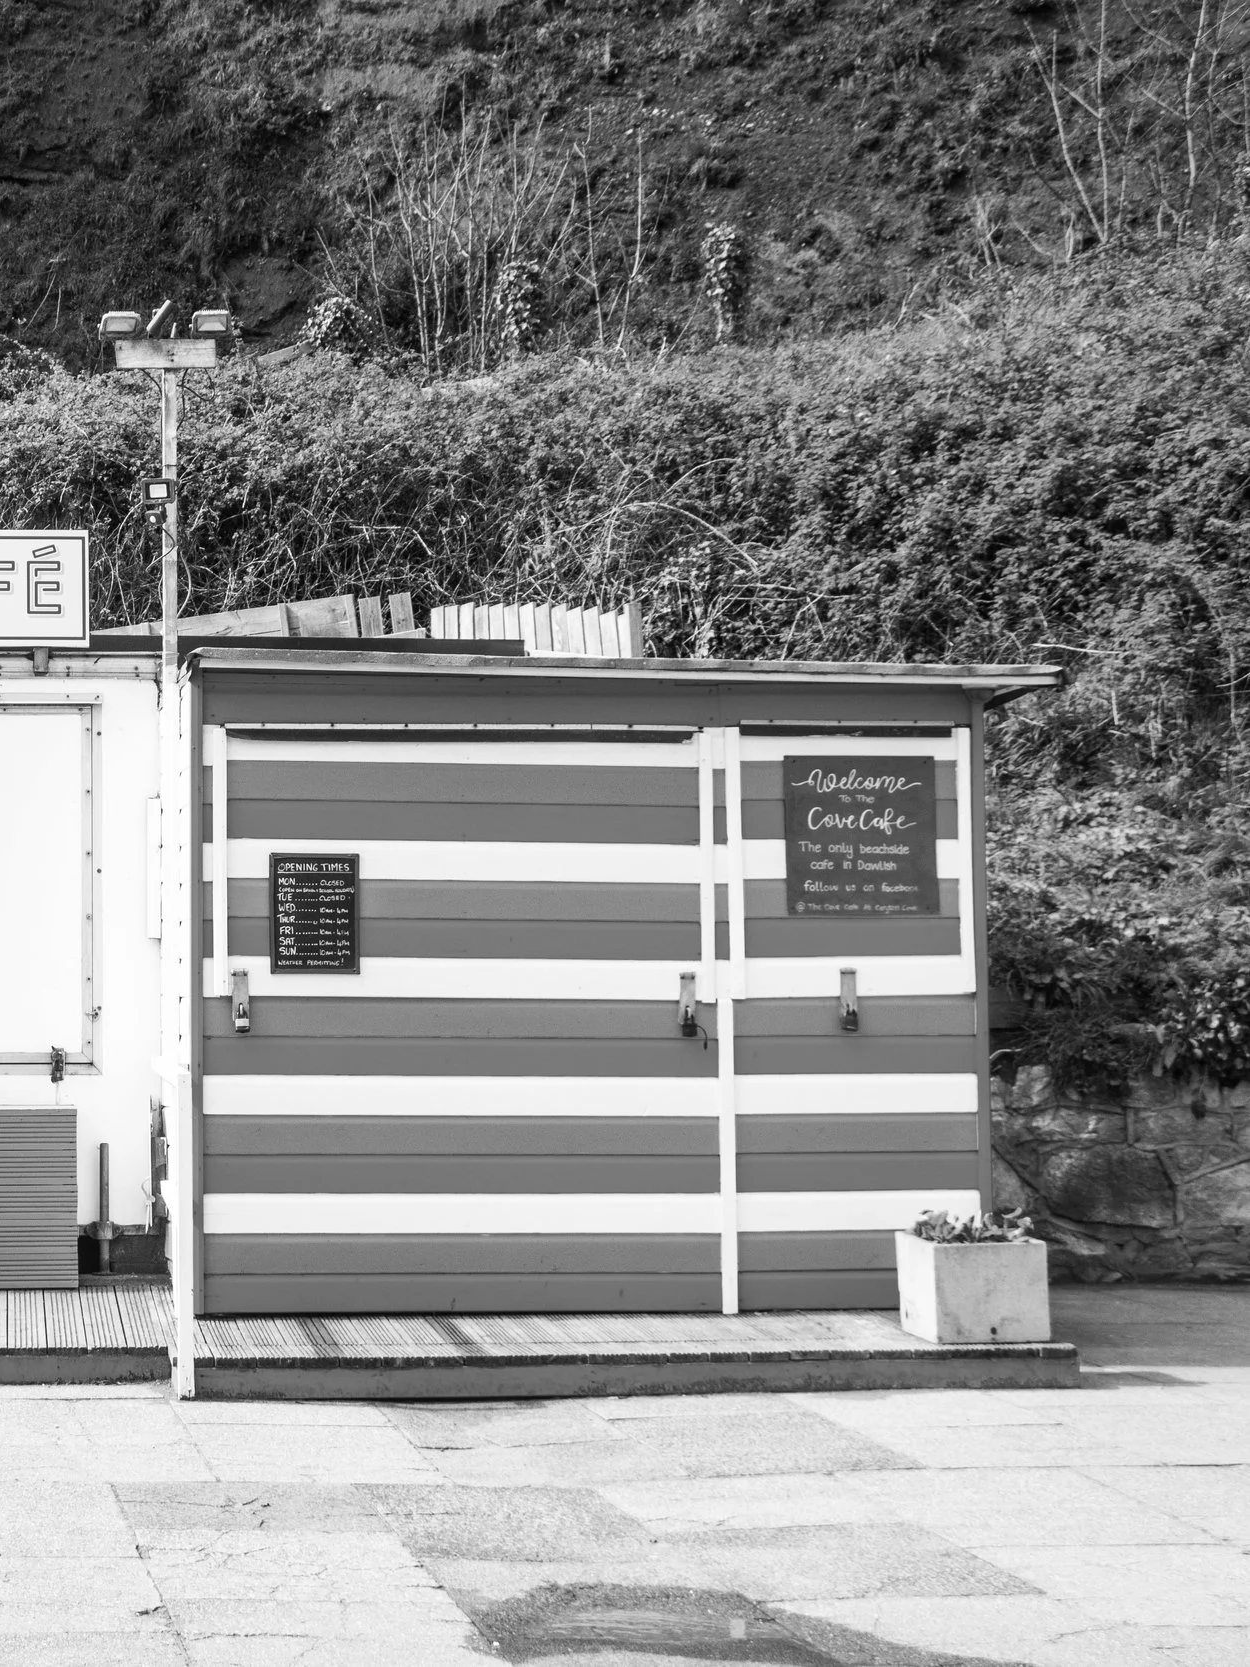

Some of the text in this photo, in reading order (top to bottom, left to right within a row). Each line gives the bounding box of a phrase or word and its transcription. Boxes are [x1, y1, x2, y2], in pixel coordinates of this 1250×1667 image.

[791, 769, 922, 793] Welcome
[838, 794, 875, 803] To The
[807, 806, 917, 834] Cove Cafe
[798, 841, 910, 858] The only beachside
[278, 862, 350, 872] OPENING TIMES
[810, 860, 834, 870] cafe
[843, 860, 852, 870] in
[278, 878, 296, 886] MON
[804, 880, 838, 892] follow
[845, 884, 856, 892] us
[862, 884, 875, 892] on
[277, 893, 293, 901] TUE
[278, 903, 296, 912] WED
[280, 926, 294, 934] FRI
[279, 936, 295, 945] SAT
[279, 946, 296, 955] SUN
